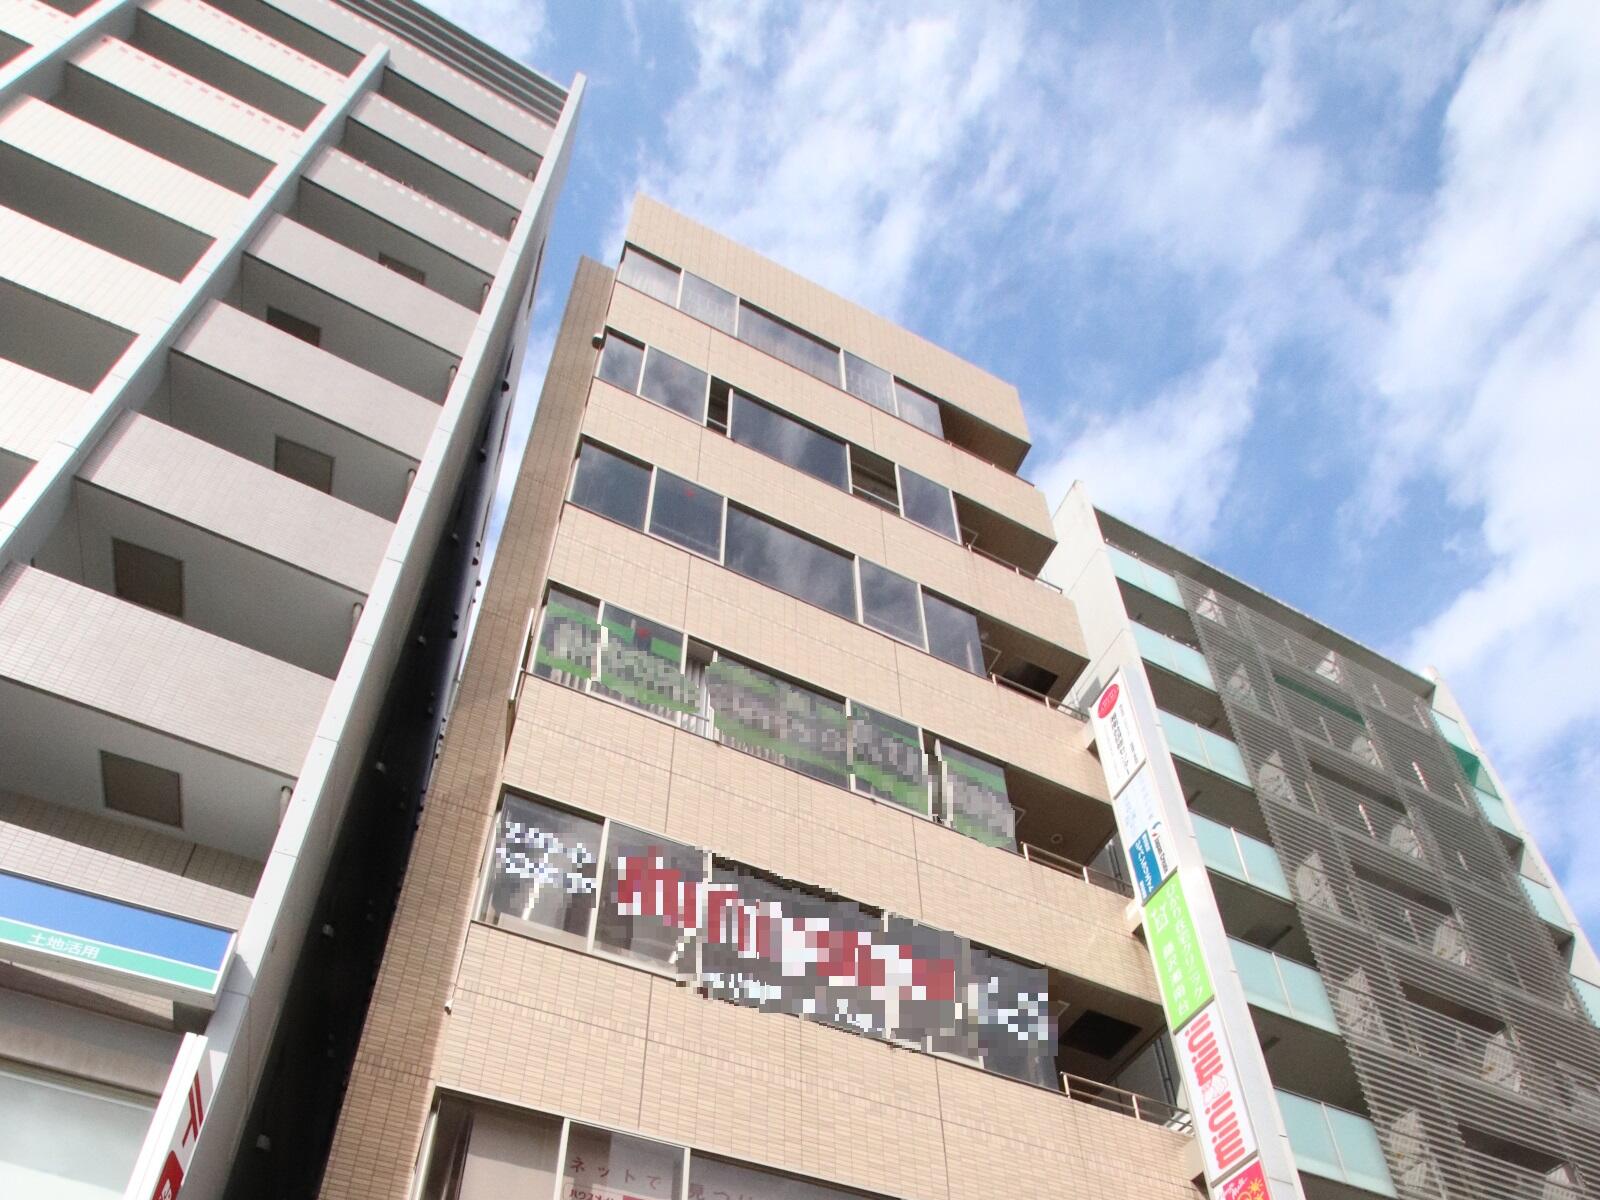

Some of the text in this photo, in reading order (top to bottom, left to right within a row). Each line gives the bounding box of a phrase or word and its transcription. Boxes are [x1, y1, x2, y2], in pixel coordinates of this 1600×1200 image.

[27, 932, 100, 960] 土地活用
[571, 1156, 662, 1190] ネットで
